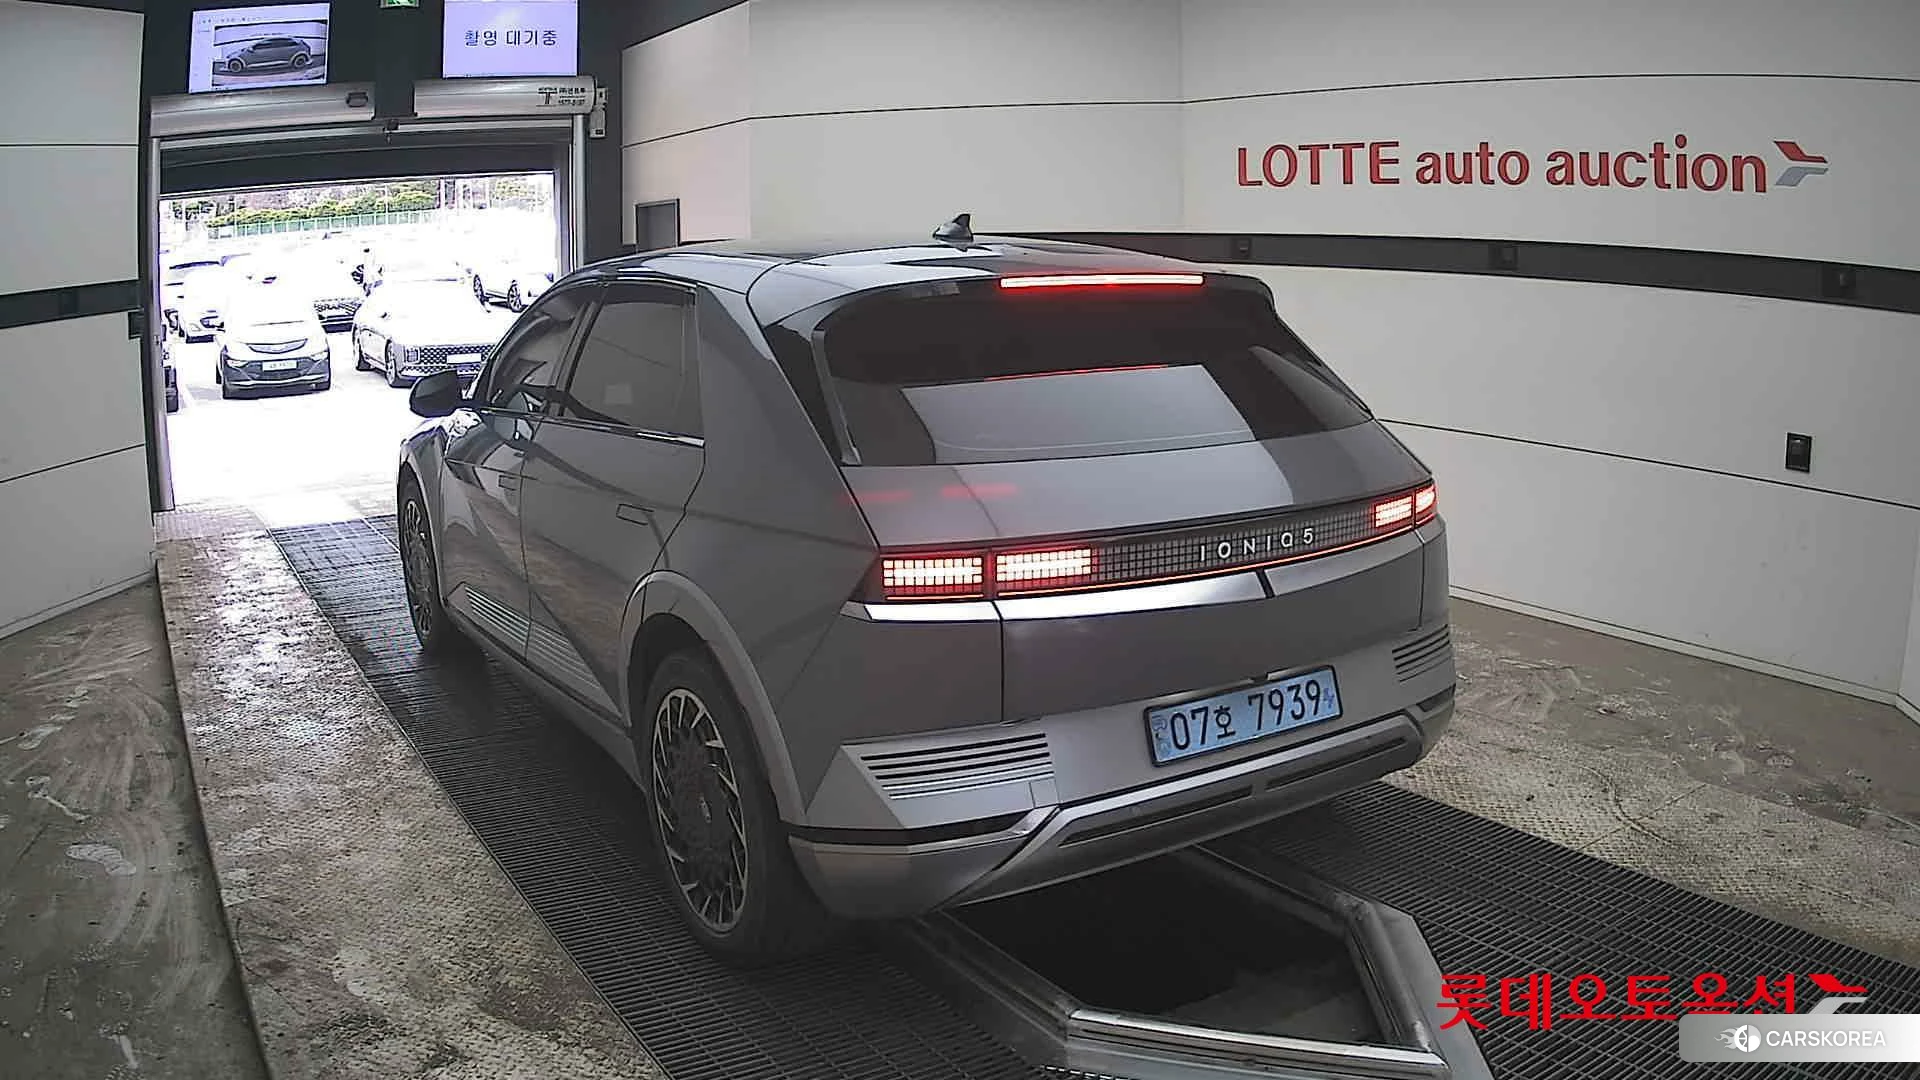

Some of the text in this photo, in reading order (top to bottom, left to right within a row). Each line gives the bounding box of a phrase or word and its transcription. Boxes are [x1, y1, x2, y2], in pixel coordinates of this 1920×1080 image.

[464, 29, 558, 47] 촬영 대기중
[1238, 133, 1767, 194] LOTTE auto auction
[1169, 679, 1321, 750] 07호 7939
